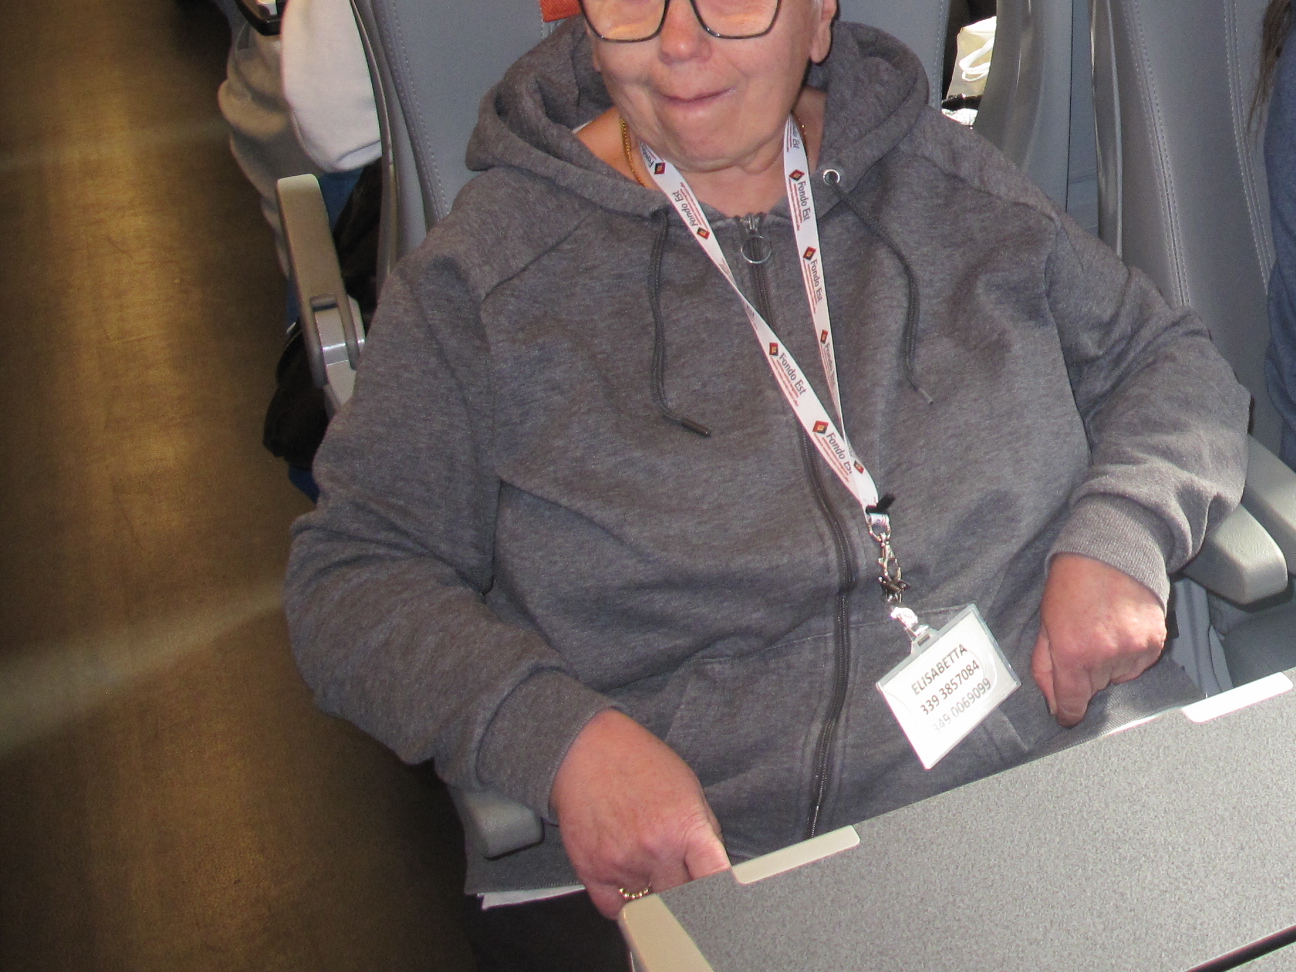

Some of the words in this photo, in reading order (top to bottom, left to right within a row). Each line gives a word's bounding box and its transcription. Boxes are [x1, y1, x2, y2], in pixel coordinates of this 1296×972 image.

[672, 190, 685, 203] Est
[797, 180, 808, 207] Fondo
[681, 202, 699, 227] Fondo
[802, 208, 811, 221] Est
[810, 259, 820, 287] Fondo
[815, 286, 823, 302] Est
[779, 352, 797, 381] Fondo
[794, 379, 807, 396] Est
[826, 432, 846, 460] Fondo
[911, 643, 968, 696] ELISABETTA
[920, 695, 940, 716] 339
[938, 659, 980, 701] 3857084
[932, 713, 951, 735] 349
[952, 678, 992, 719] 0069099
